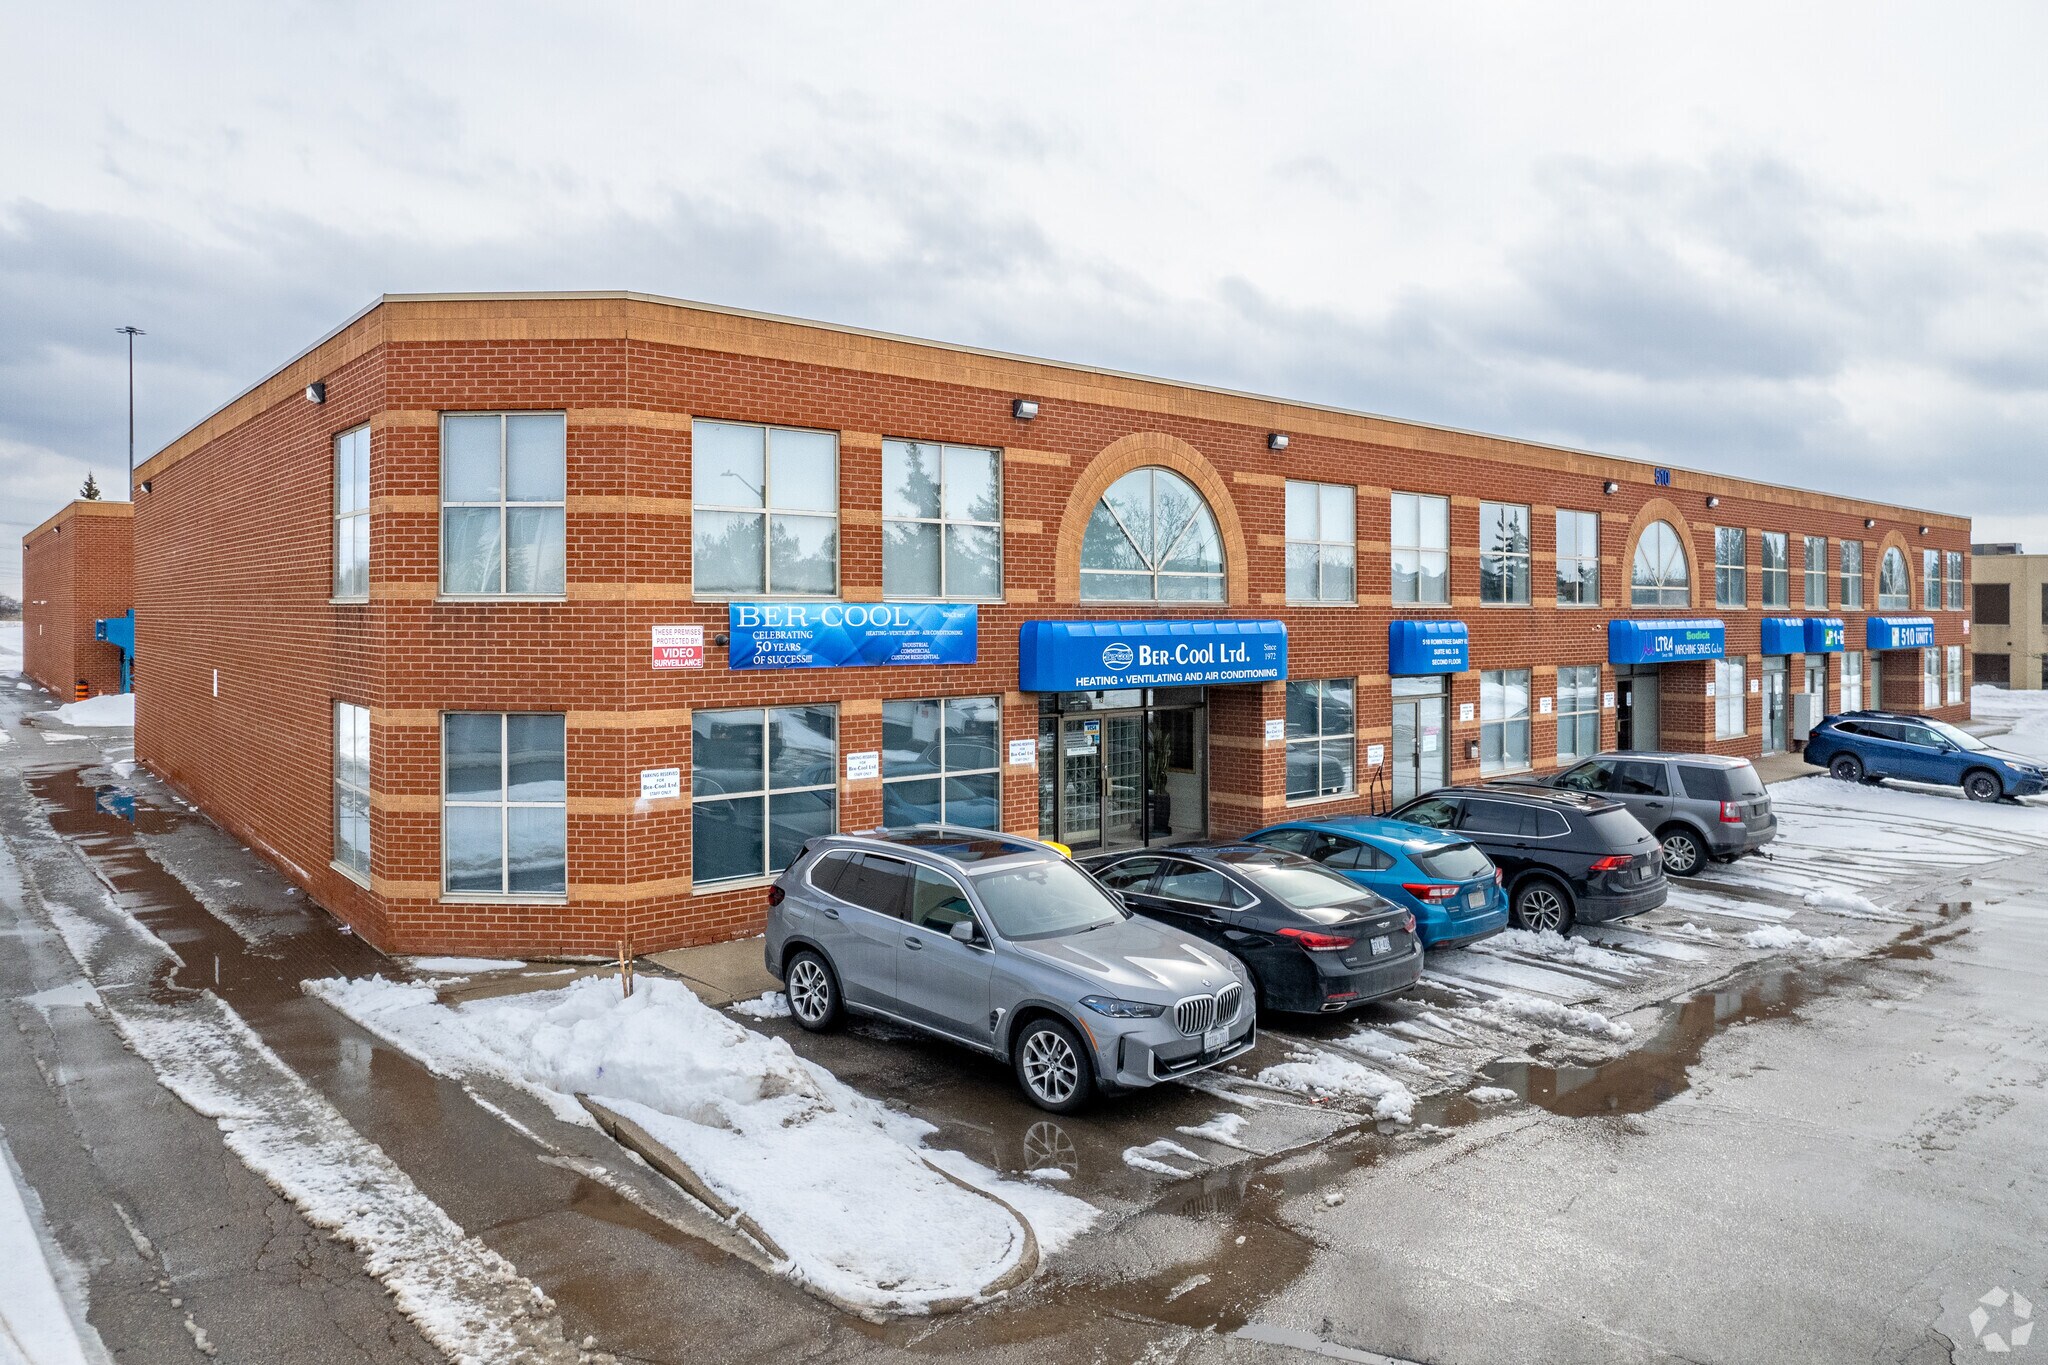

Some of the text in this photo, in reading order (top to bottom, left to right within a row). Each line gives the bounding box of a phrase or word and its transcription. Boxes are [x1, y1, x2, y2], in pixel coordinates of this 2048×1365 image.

[1654, 467, 1671, 486] 510
[736, 605, 910, 627] BER-COOL
[654, 628, 702, 636] THESE PREMISES
[752, 630, 813, 640] CELEBRATING
[1901, 627, 1915, 646] 510
[656, 637, 690, 645] PROTECTED
[1915, 631, 1929, 644] UNIT
[755, 641, 801, 655] 50 YEARS
[1263, 643, 1277, 651] Since
[661, 647, 695, 659] VIDEO
[1264, 652, 1277, 660] 1972
[654, 658, 702, 667] SURVEILLANCE
[753, 655, 767, 665] OF
[1431, 658, 1448, 666] SECOND
[1075, 668, 1278, 687] HEATING VENTILATING AND AIR CONDITIONING
